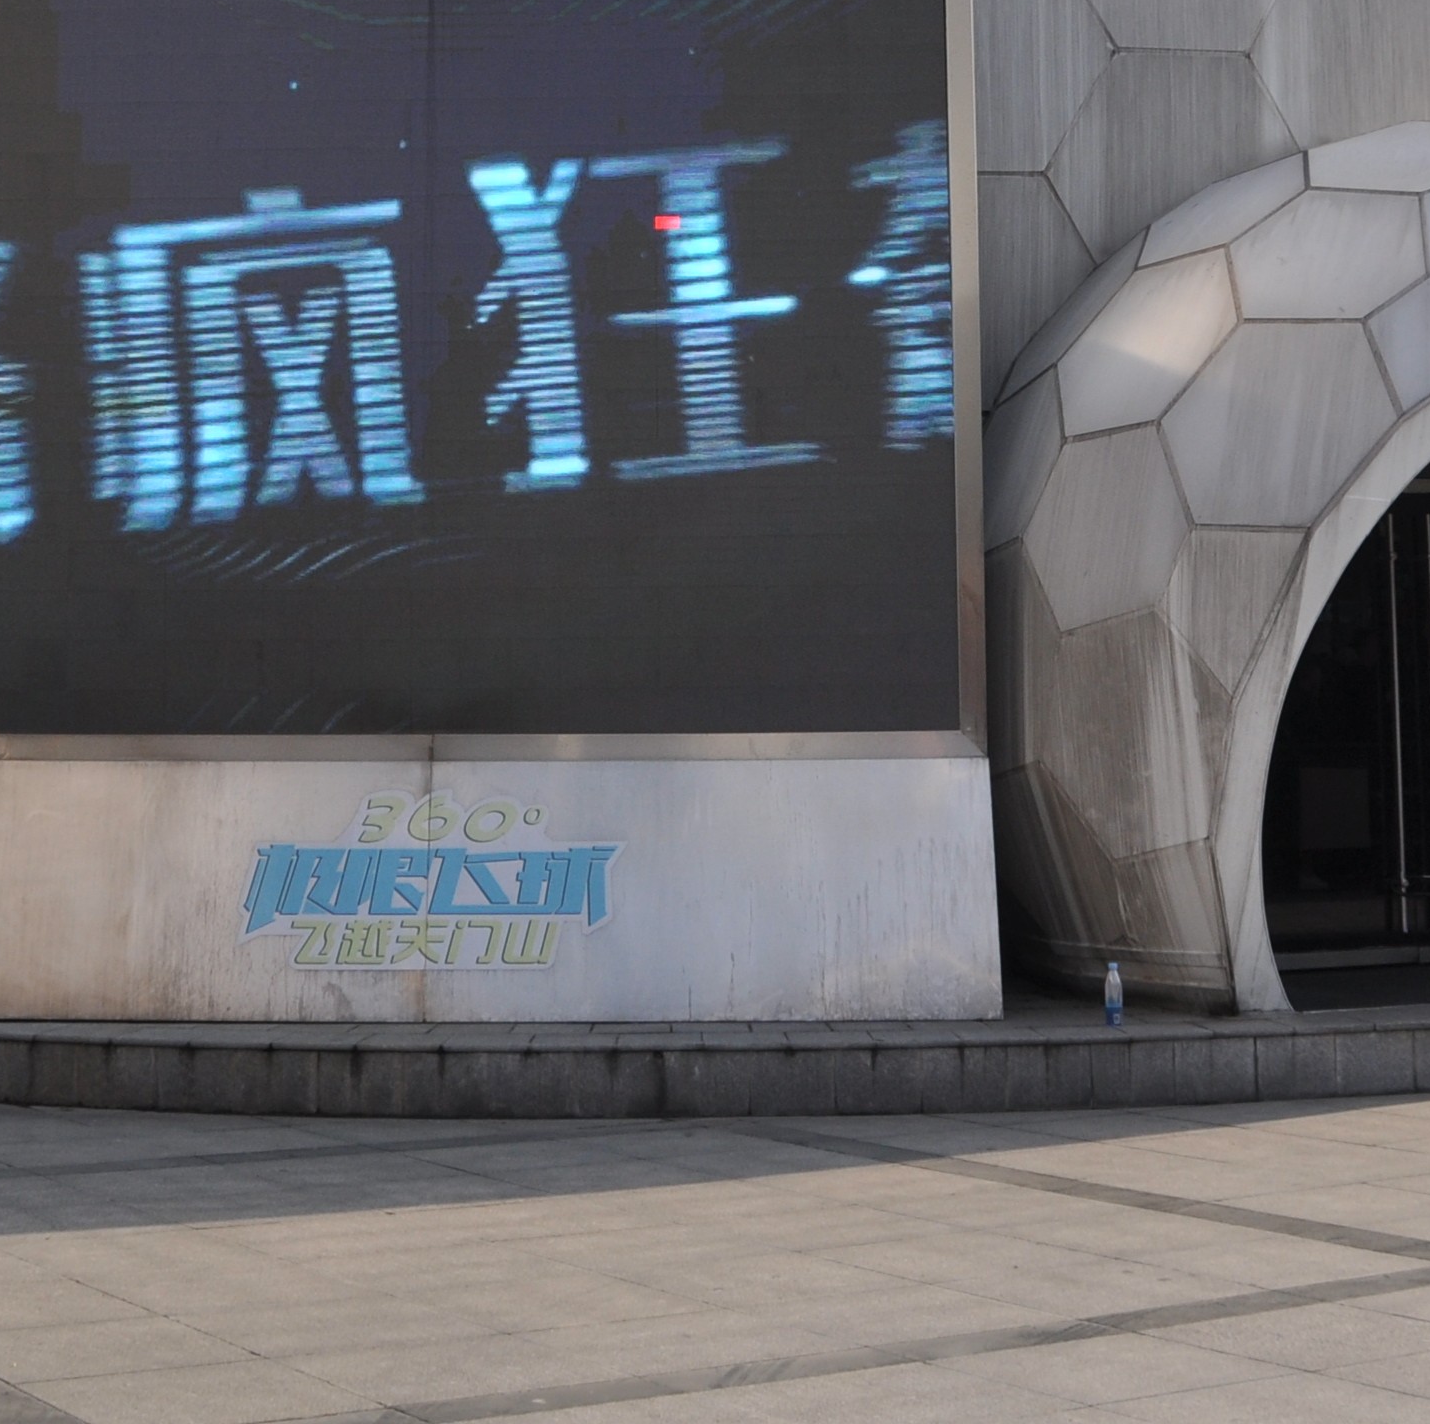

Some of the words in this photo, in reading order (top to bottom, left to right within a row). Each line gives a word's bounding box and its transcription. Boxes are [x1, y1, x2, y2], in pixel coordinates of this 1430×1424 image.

[244, 843, 621, 935] 极限飞球
[290, 919, 559, 965] 飞越天门山
